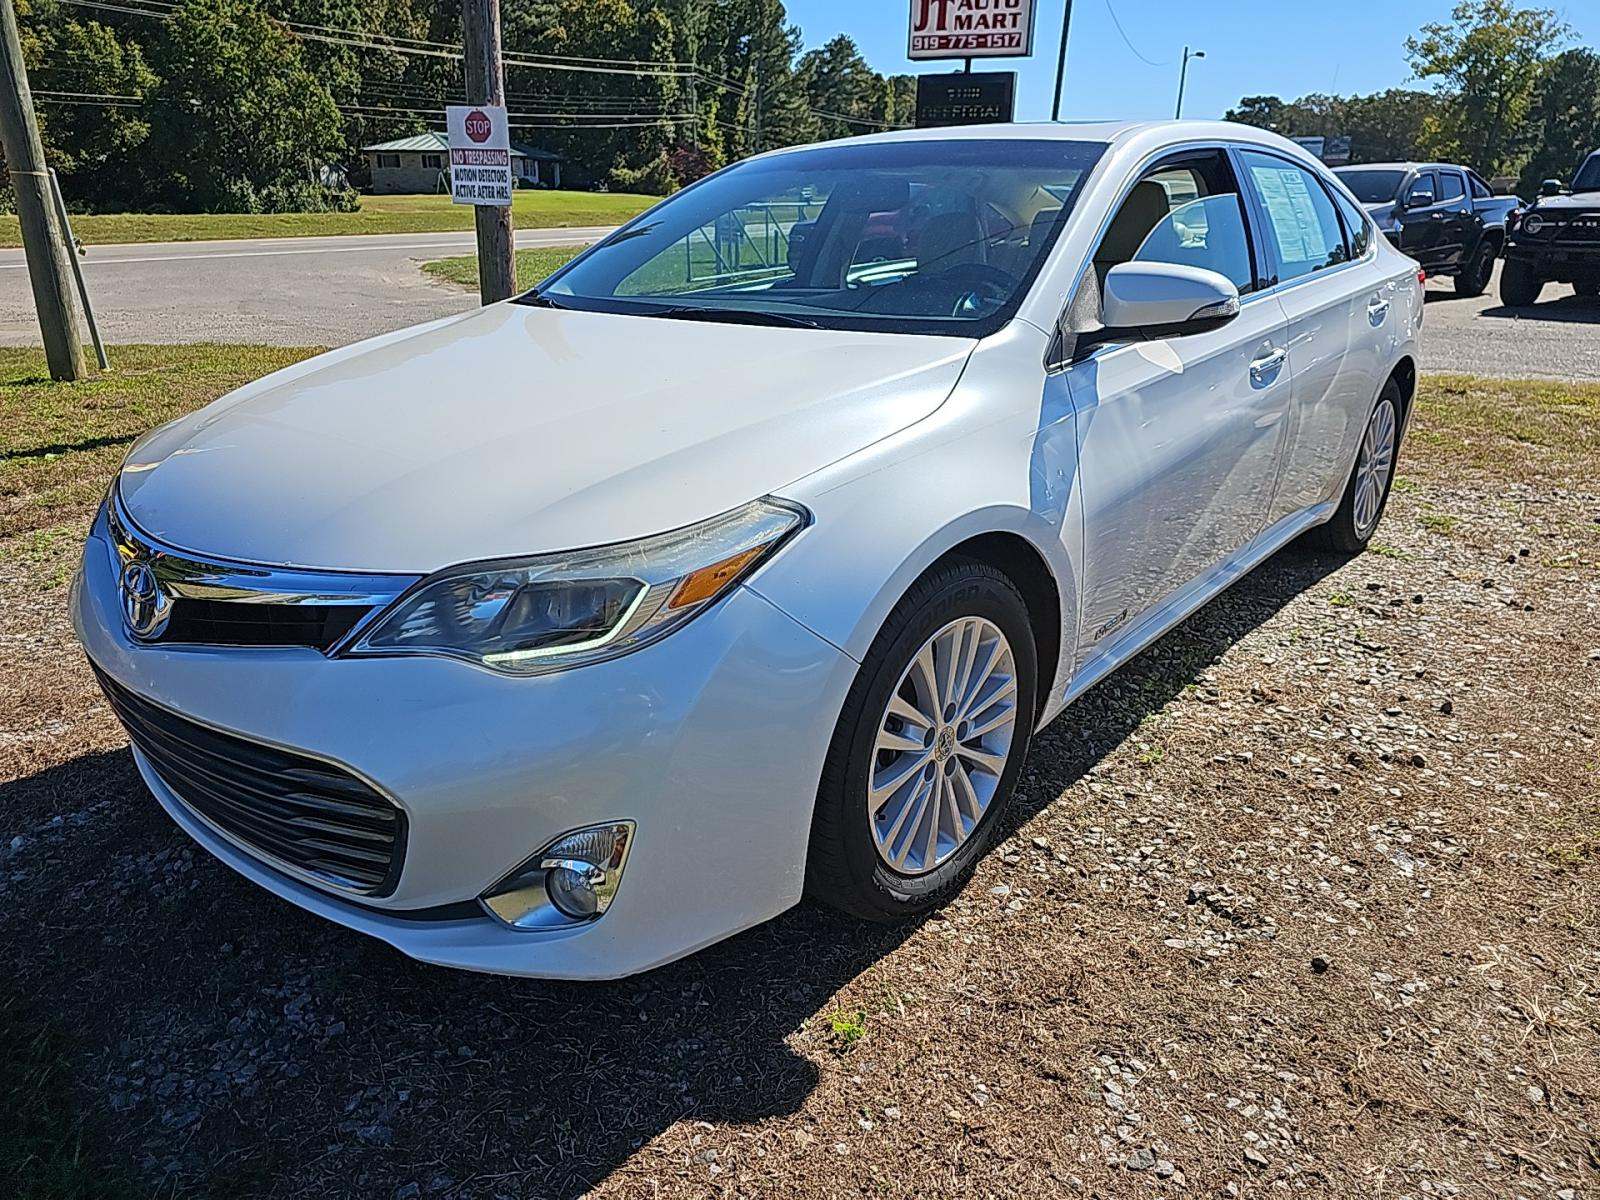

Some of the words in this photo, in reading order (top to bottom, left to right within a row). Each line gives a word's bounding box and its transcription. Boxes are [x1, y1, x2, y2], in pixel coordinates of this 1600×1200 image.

[914, 0, 955, 32] JT
[957, 0, 1020, 11] AUTO
[953, 12, 1022, 31] MART
[913, 34, 1019, 50] 919-775-1517
[466, 121, 490, 134] STOP
[453, 150, 464, 164] NO
[465, 150, 507, 165] TRESPASSING
[454, 168, 477, 181] MOTION
[478, 169, 507, 183] DETECTORS
[455, 185, 476, 198] ACTIVE
[477, 185, 496, 199] AFTER
